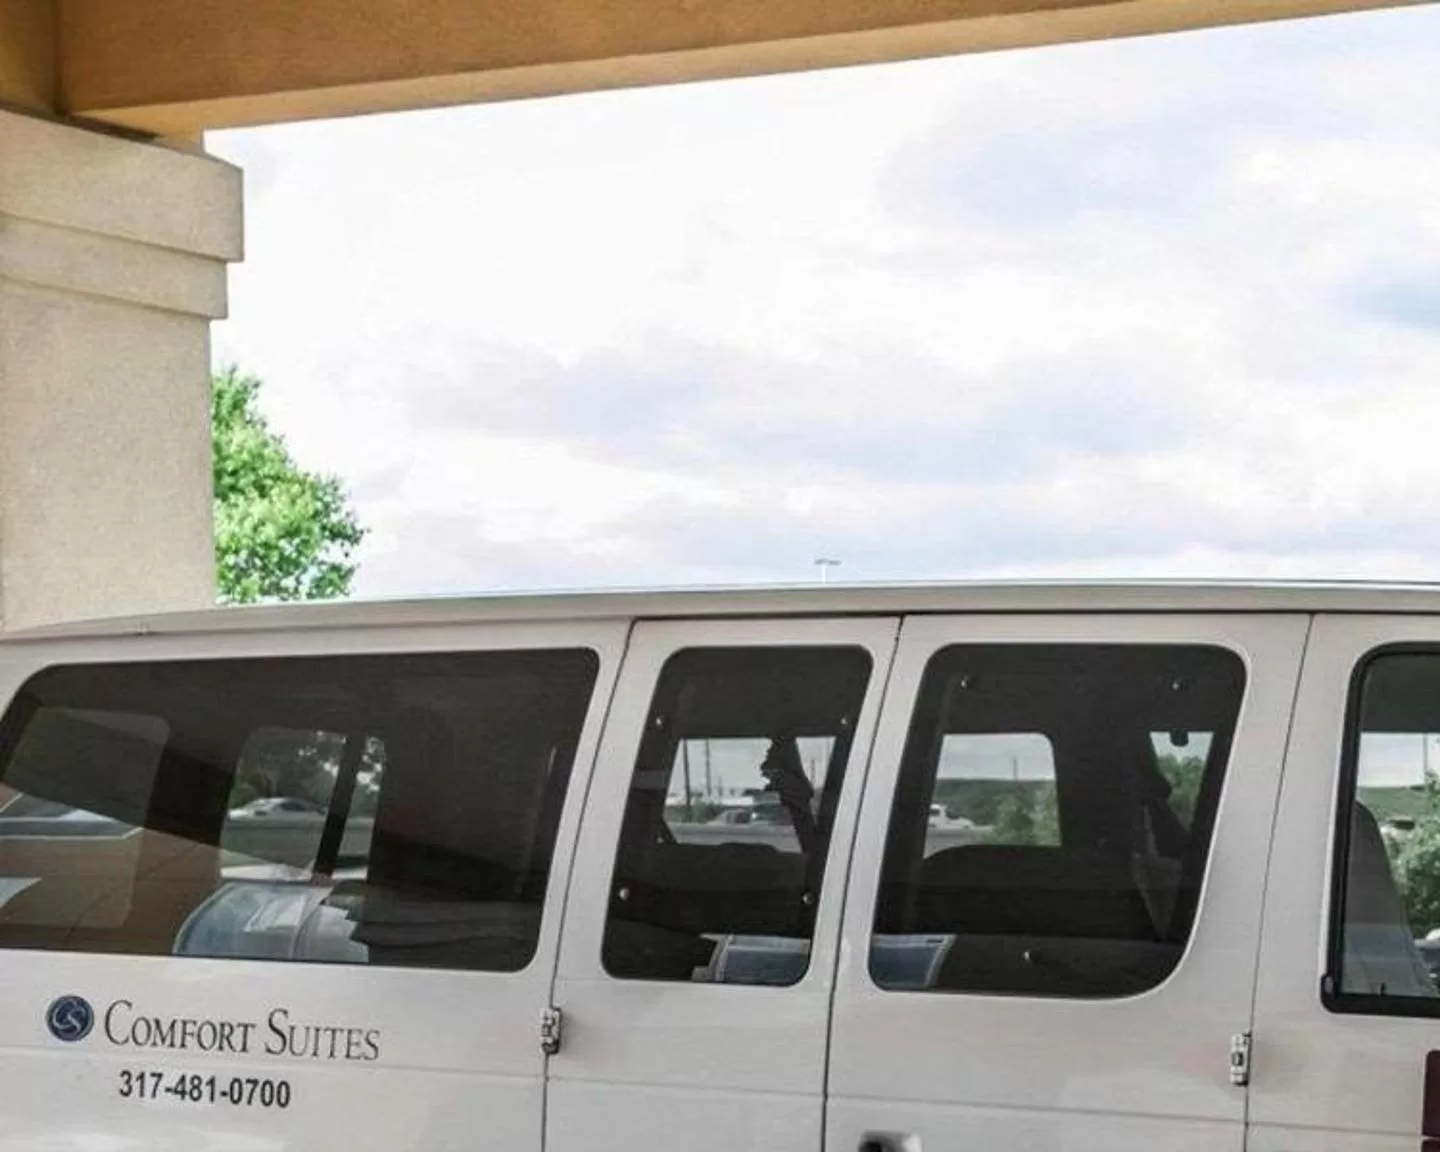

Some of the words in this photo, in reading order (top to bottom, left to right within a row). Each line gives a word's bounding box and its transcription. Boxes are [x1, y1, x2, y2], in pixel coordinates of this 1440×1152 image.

[104, 1000, 256, 1051] COMFORT
[264, 1007, 381, 1061] SUITES
[119, 1070, 291, 1108] 317-481-0700
